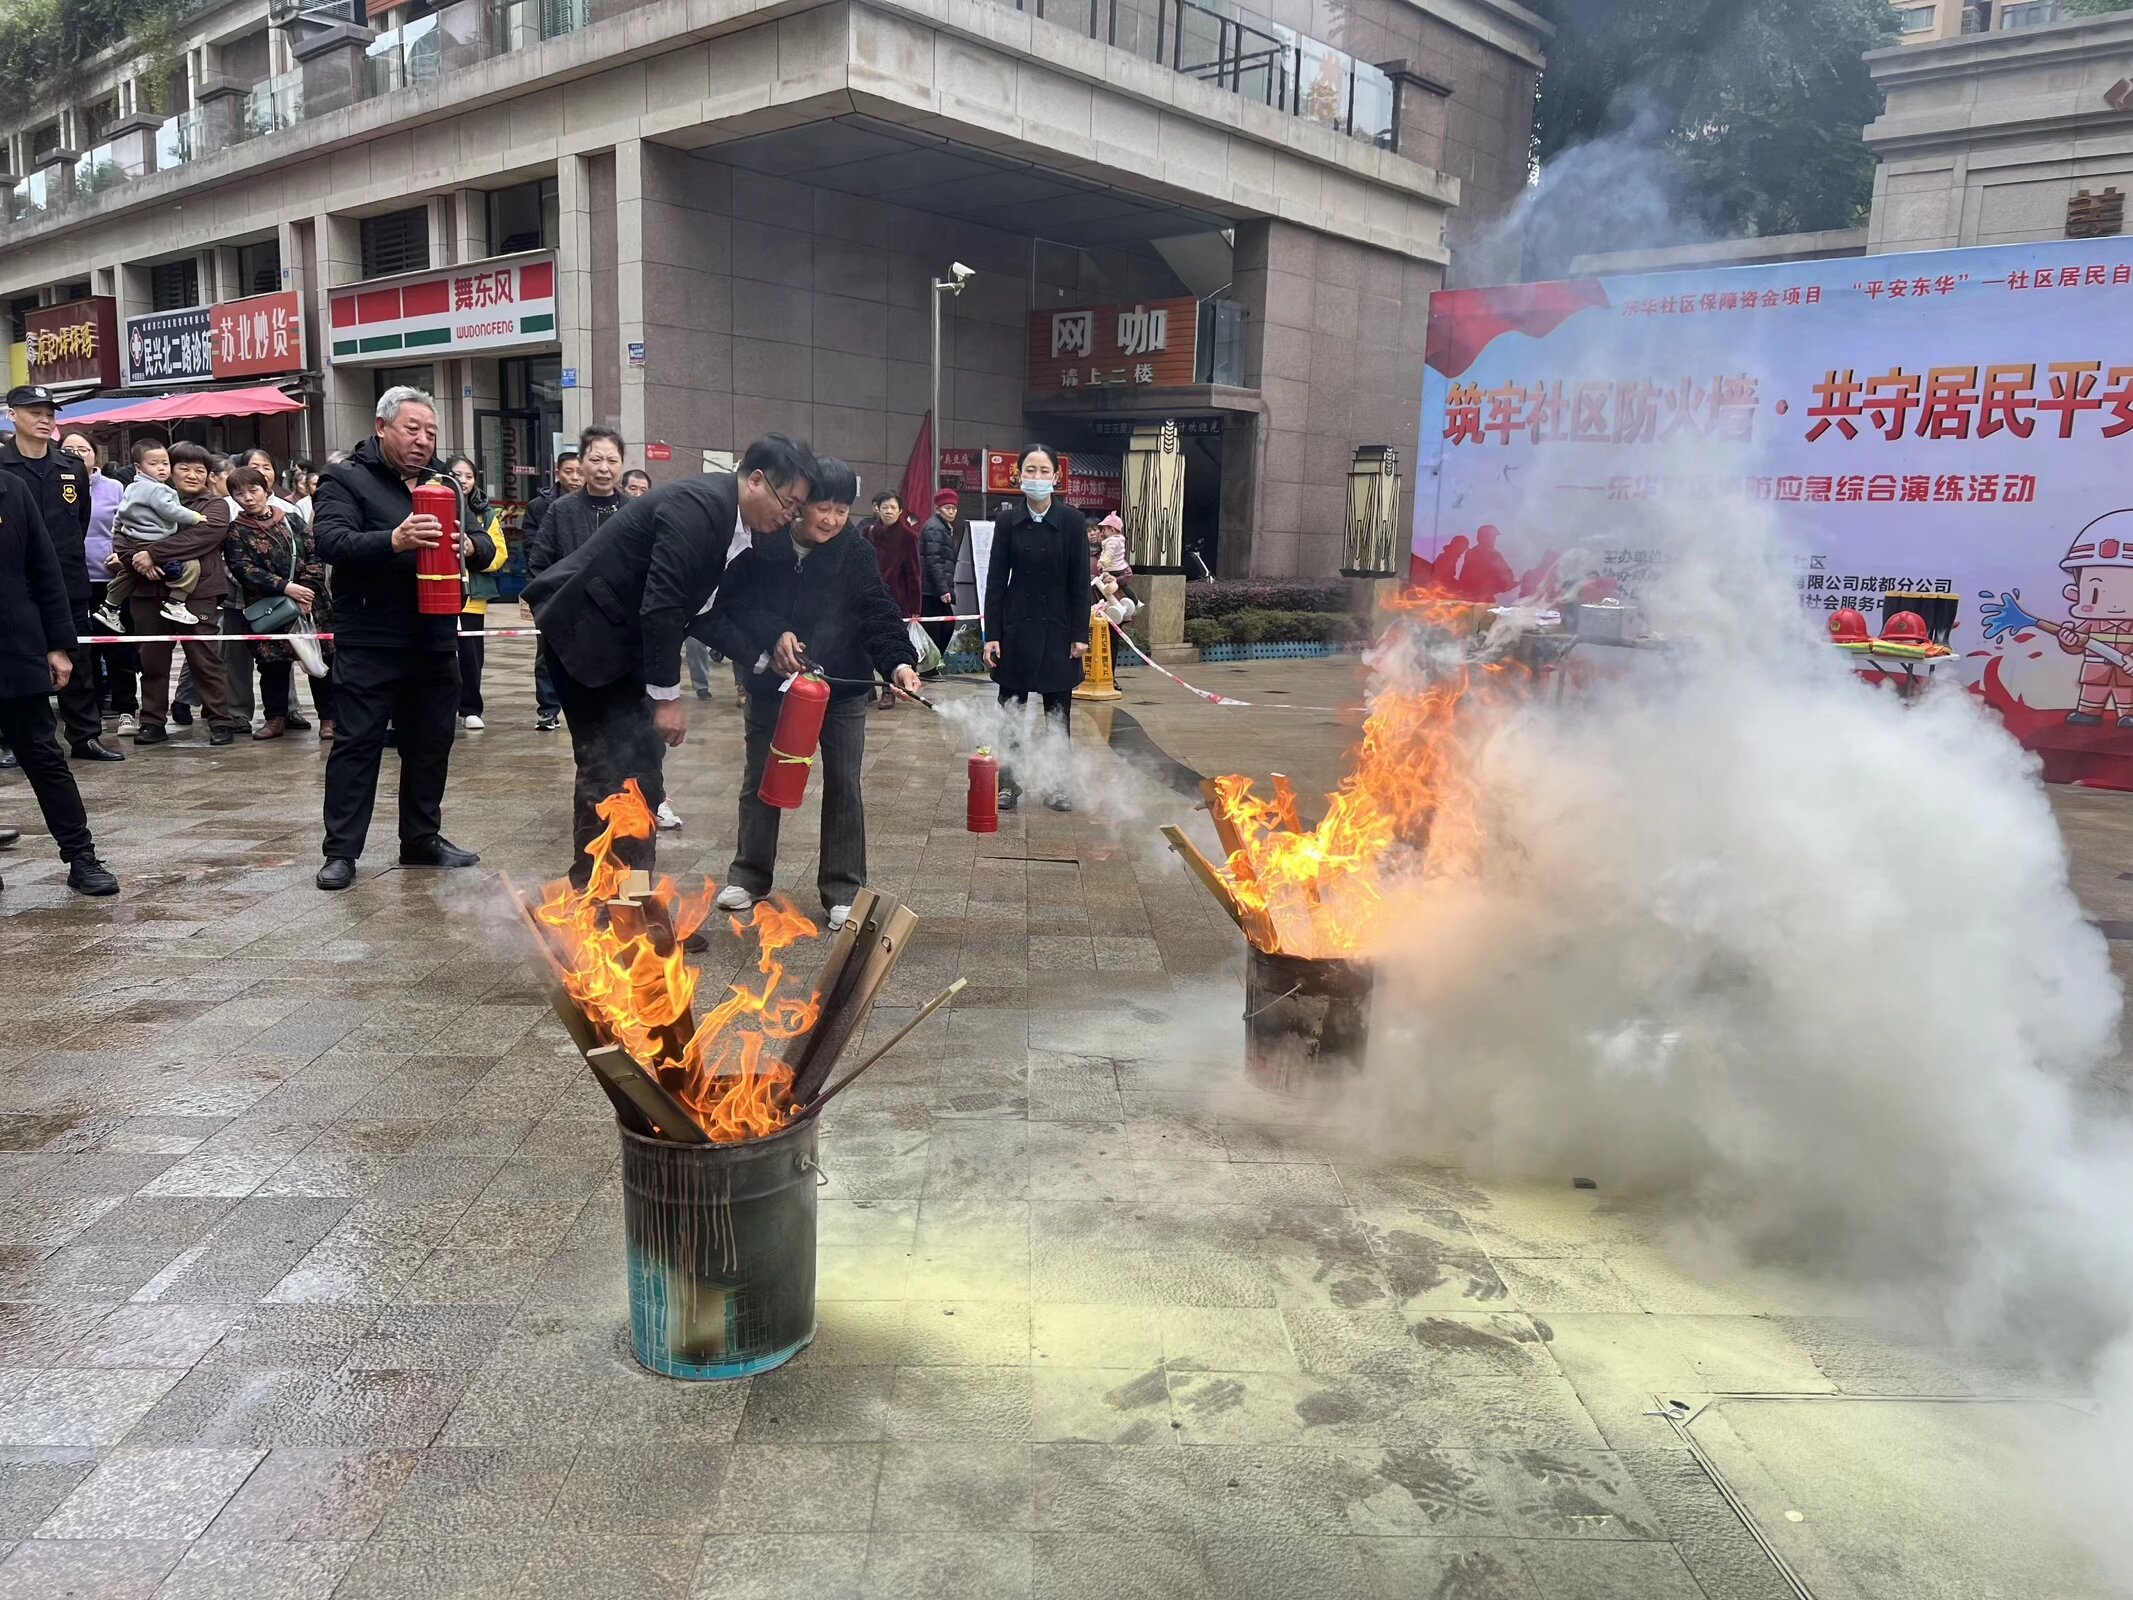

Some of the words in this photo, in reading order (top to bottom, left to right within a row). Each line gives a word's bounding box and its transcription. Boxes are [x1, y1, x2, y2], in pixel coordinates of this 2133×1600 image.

[454, 269, 514, 312] 舞东风
[220, 307, 289, 363] 苏北炒货
[456, 320, 514, 339] WUDONGFENG
[1052, 305, 1168, 358] 网咖
[1061, 364, 1153, 387] 请上二楼
